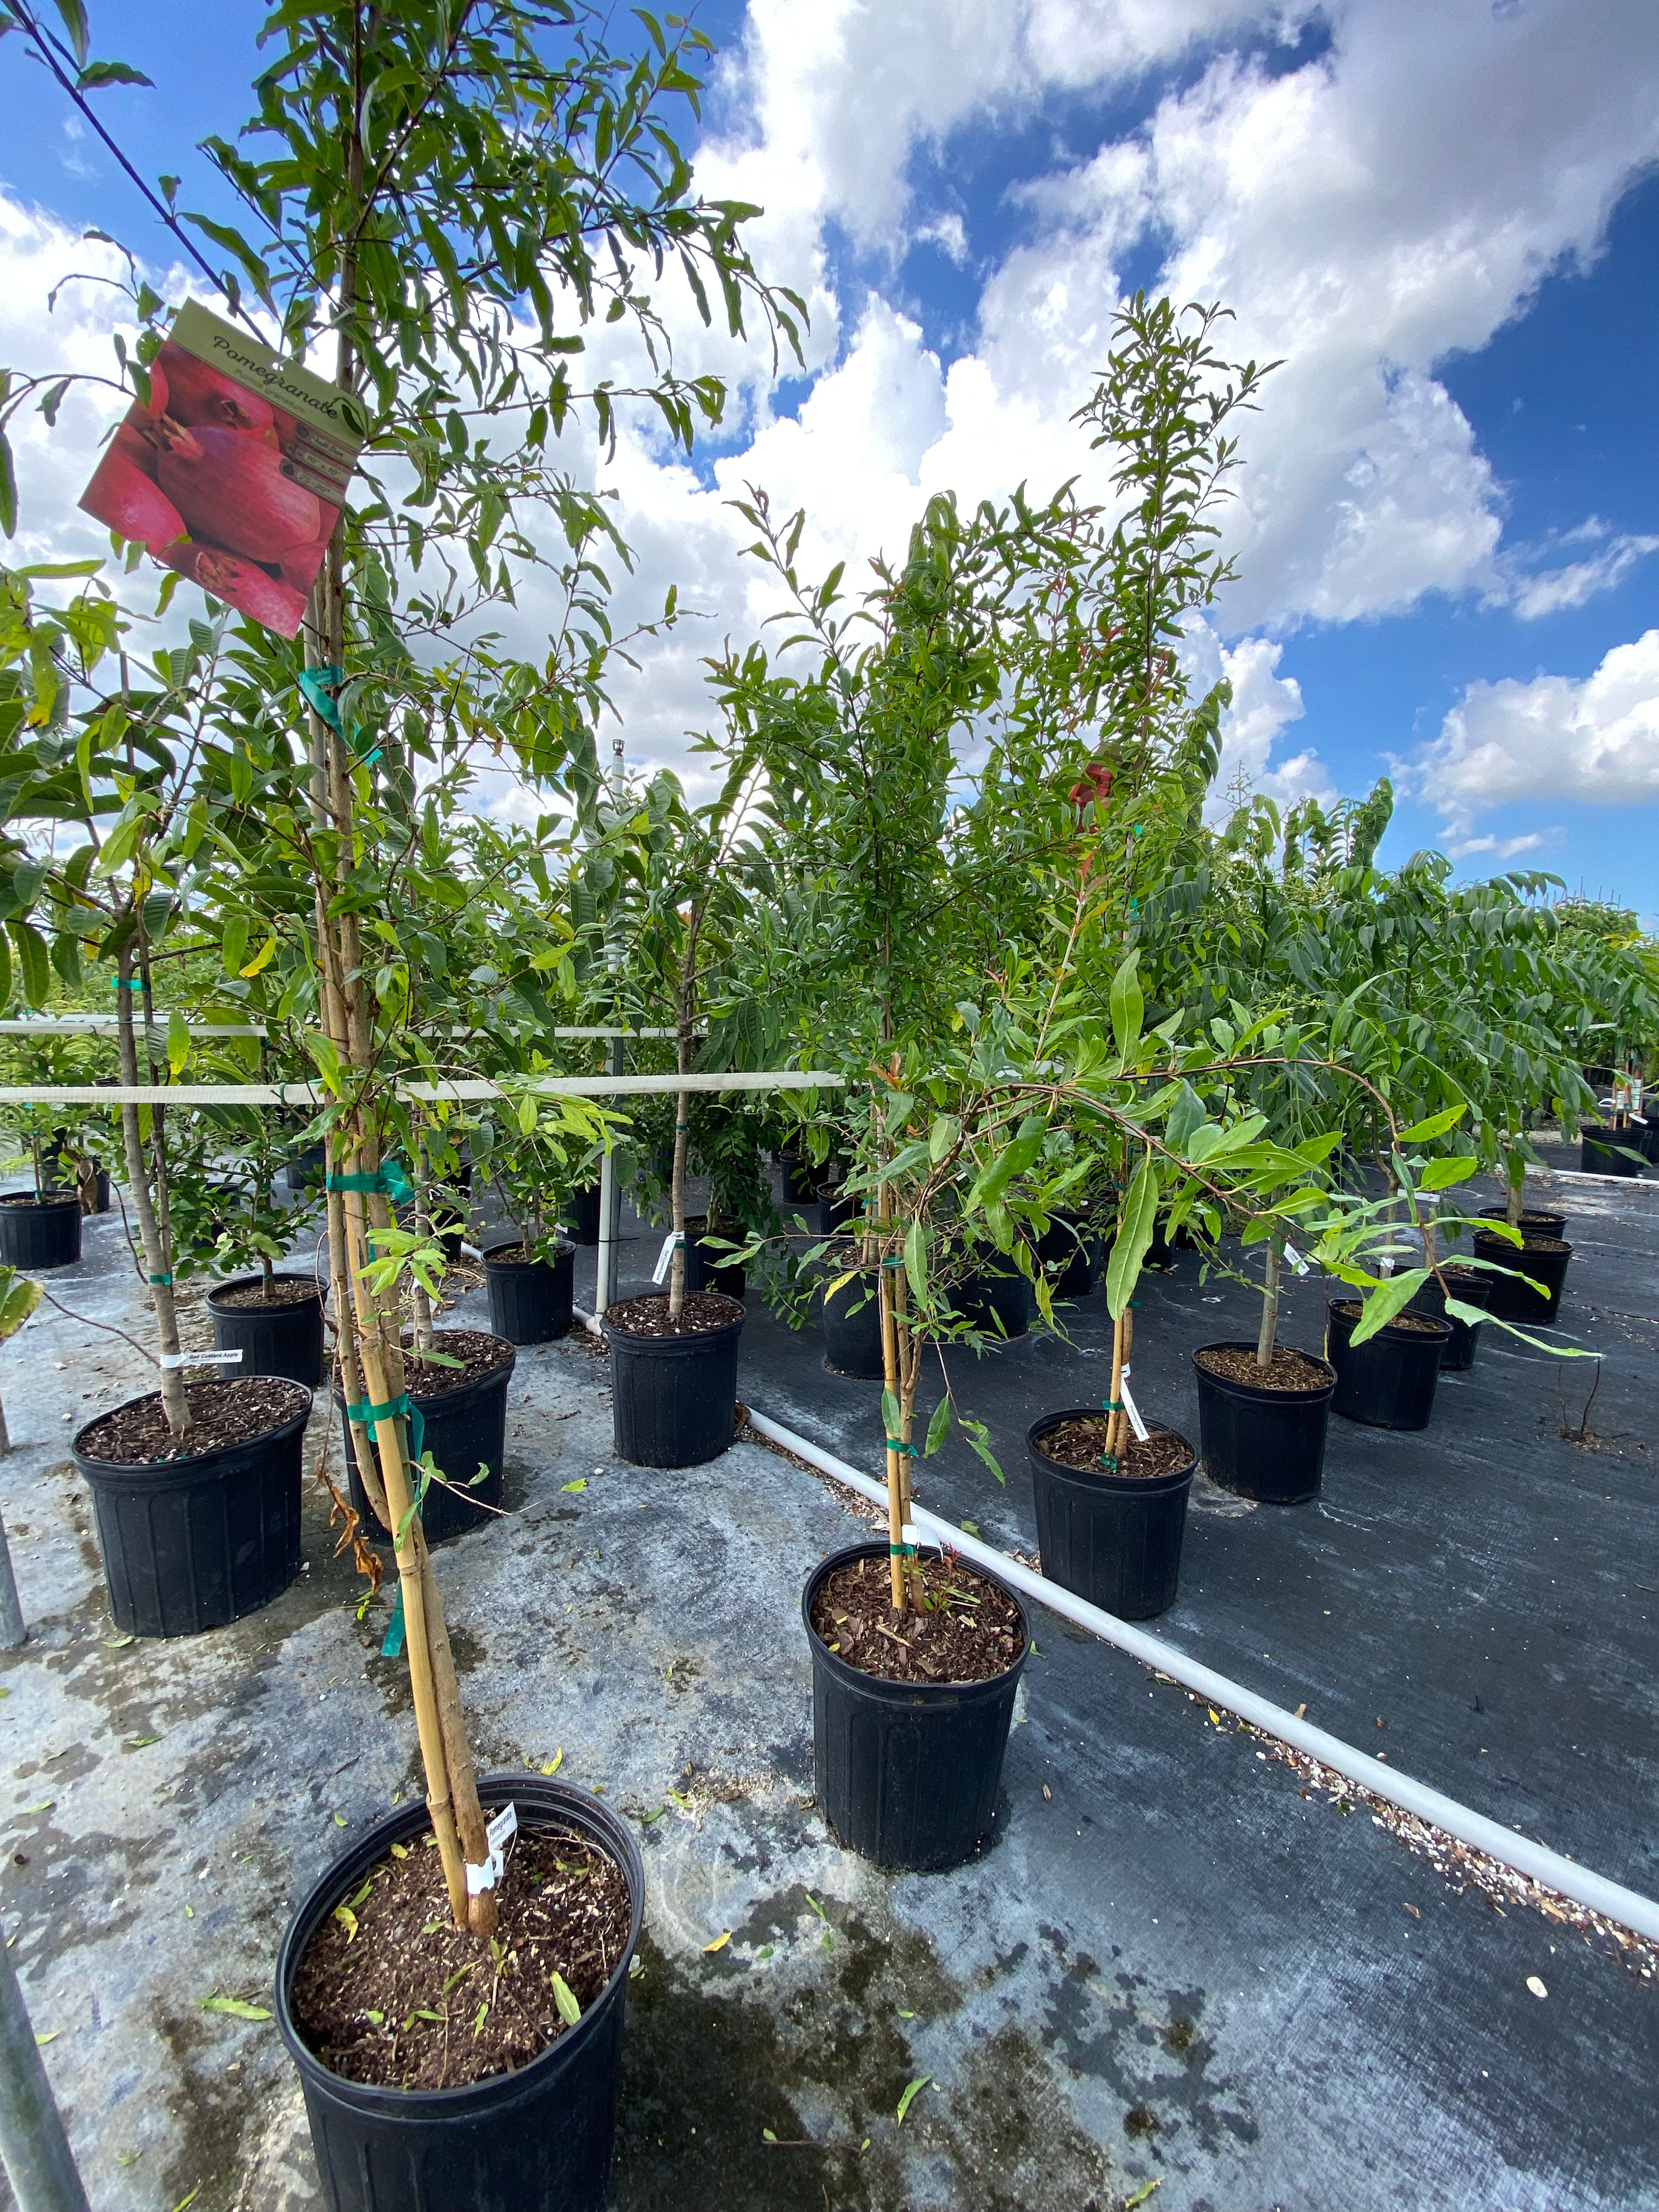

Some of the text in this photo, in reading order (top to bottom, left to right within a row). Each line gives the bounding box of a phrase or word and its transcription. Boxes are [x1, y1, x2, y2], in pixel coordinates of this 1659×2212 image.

[213, 335, 338, 419] Pomegranate
[234, 368, 306, 414] Punica granatum
[329, 445, 344, 458] Sun
[1129, 1405, 1144, 1436] Pomegranate
